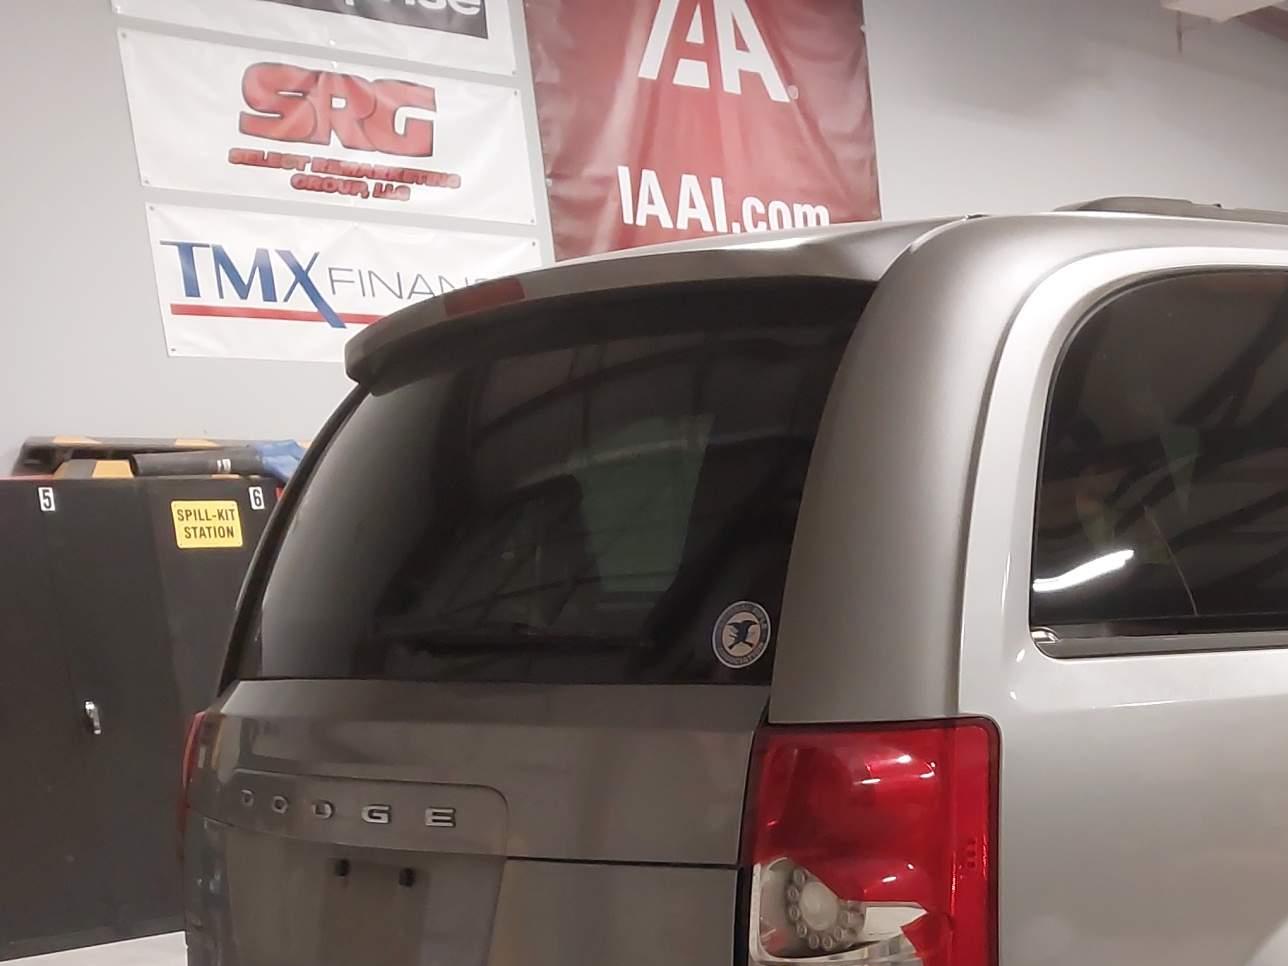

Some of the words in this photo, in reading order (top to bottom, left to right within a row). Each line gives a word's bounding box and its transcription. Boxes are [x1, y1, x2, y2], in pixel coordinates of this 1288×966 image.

[239, 62, 436, 157] SRG
[617, 165, 830, 233] IAAI.com
[160, 240, 346, 329] TMX
[42, 489, 53, 509] 5
[252, 488, 263, 508] 6
[176, 508, 236, 521] SPILL-KIT
[184, 525, 235, 539] STATION
[241, 789, 456, 828] DODGE
